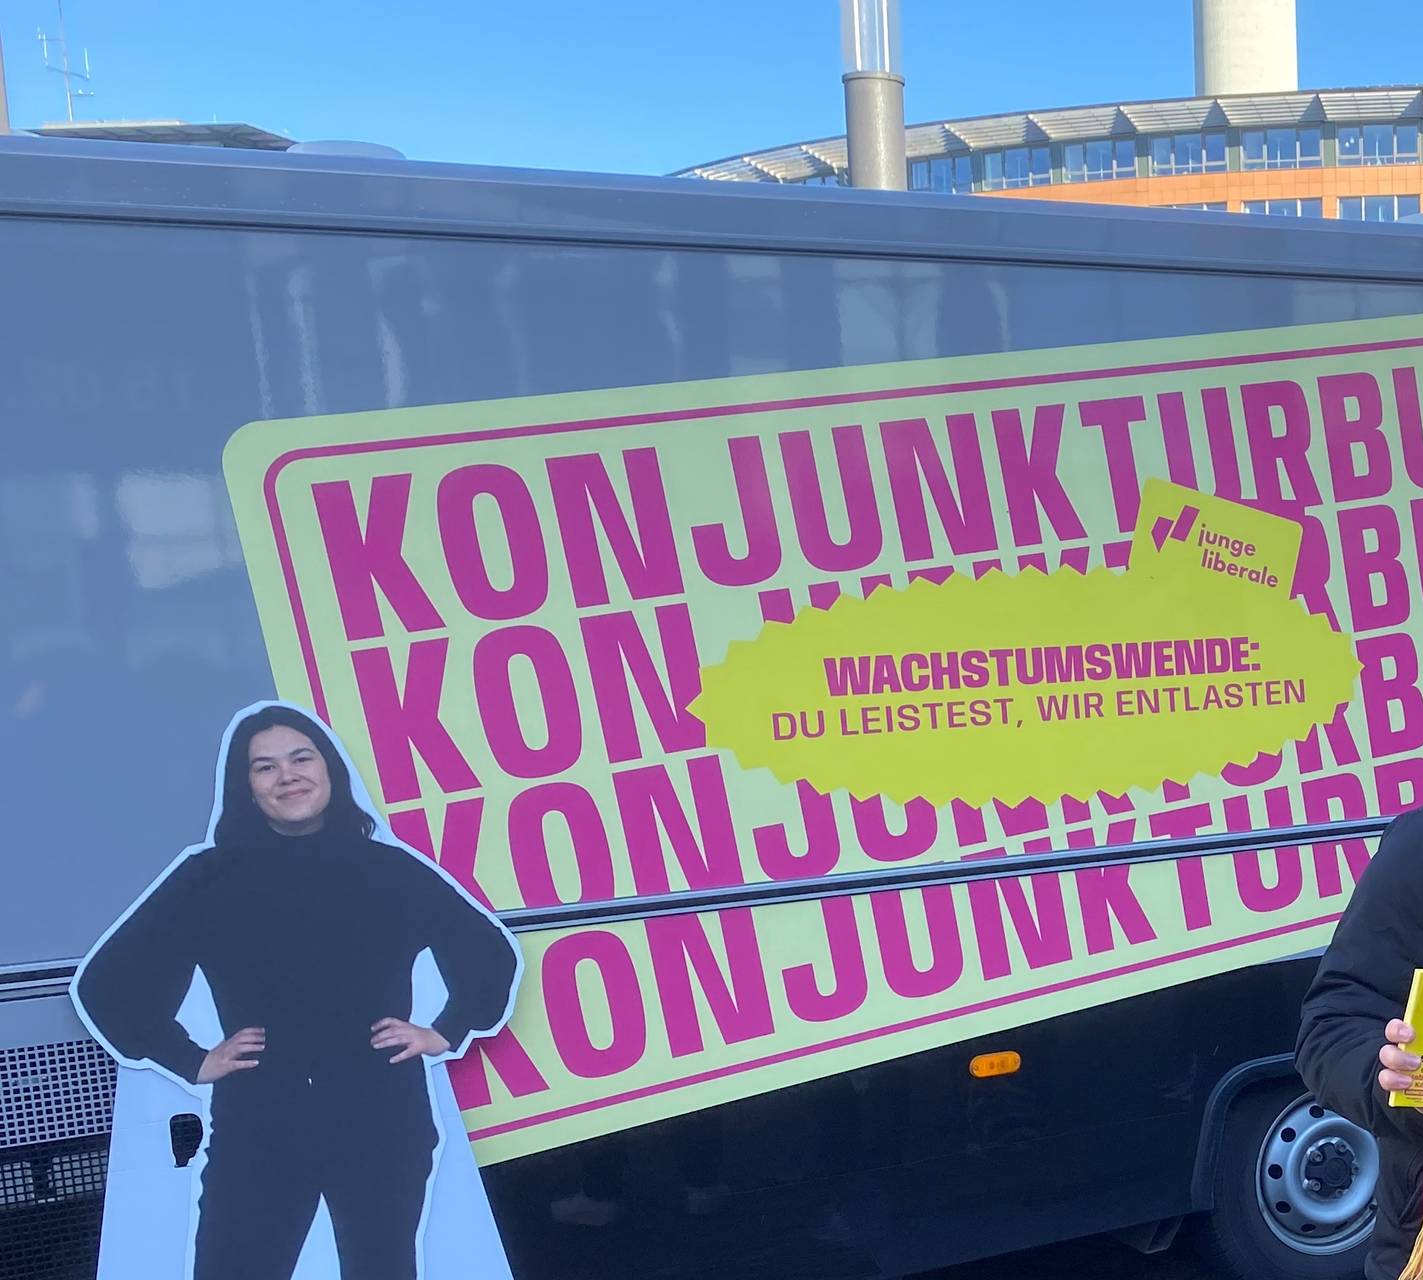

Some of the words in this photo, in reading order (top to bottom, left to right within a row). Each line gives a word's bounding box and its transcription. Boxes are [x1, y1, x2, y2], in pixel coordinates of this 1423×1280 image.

[1198, 522, 1257, 558] junge
[1201, 548, 1279, 588] liberale
[823, 636, 1262, 697] WACHSTUMSWENDE:
[771, 709, 826, 742] DU
[840, 697, 1024, 737] LEISTEST,
[1036, 691, 1105, 724] WIR
[1116, 678, 1307, 718] ENTLASTEN
